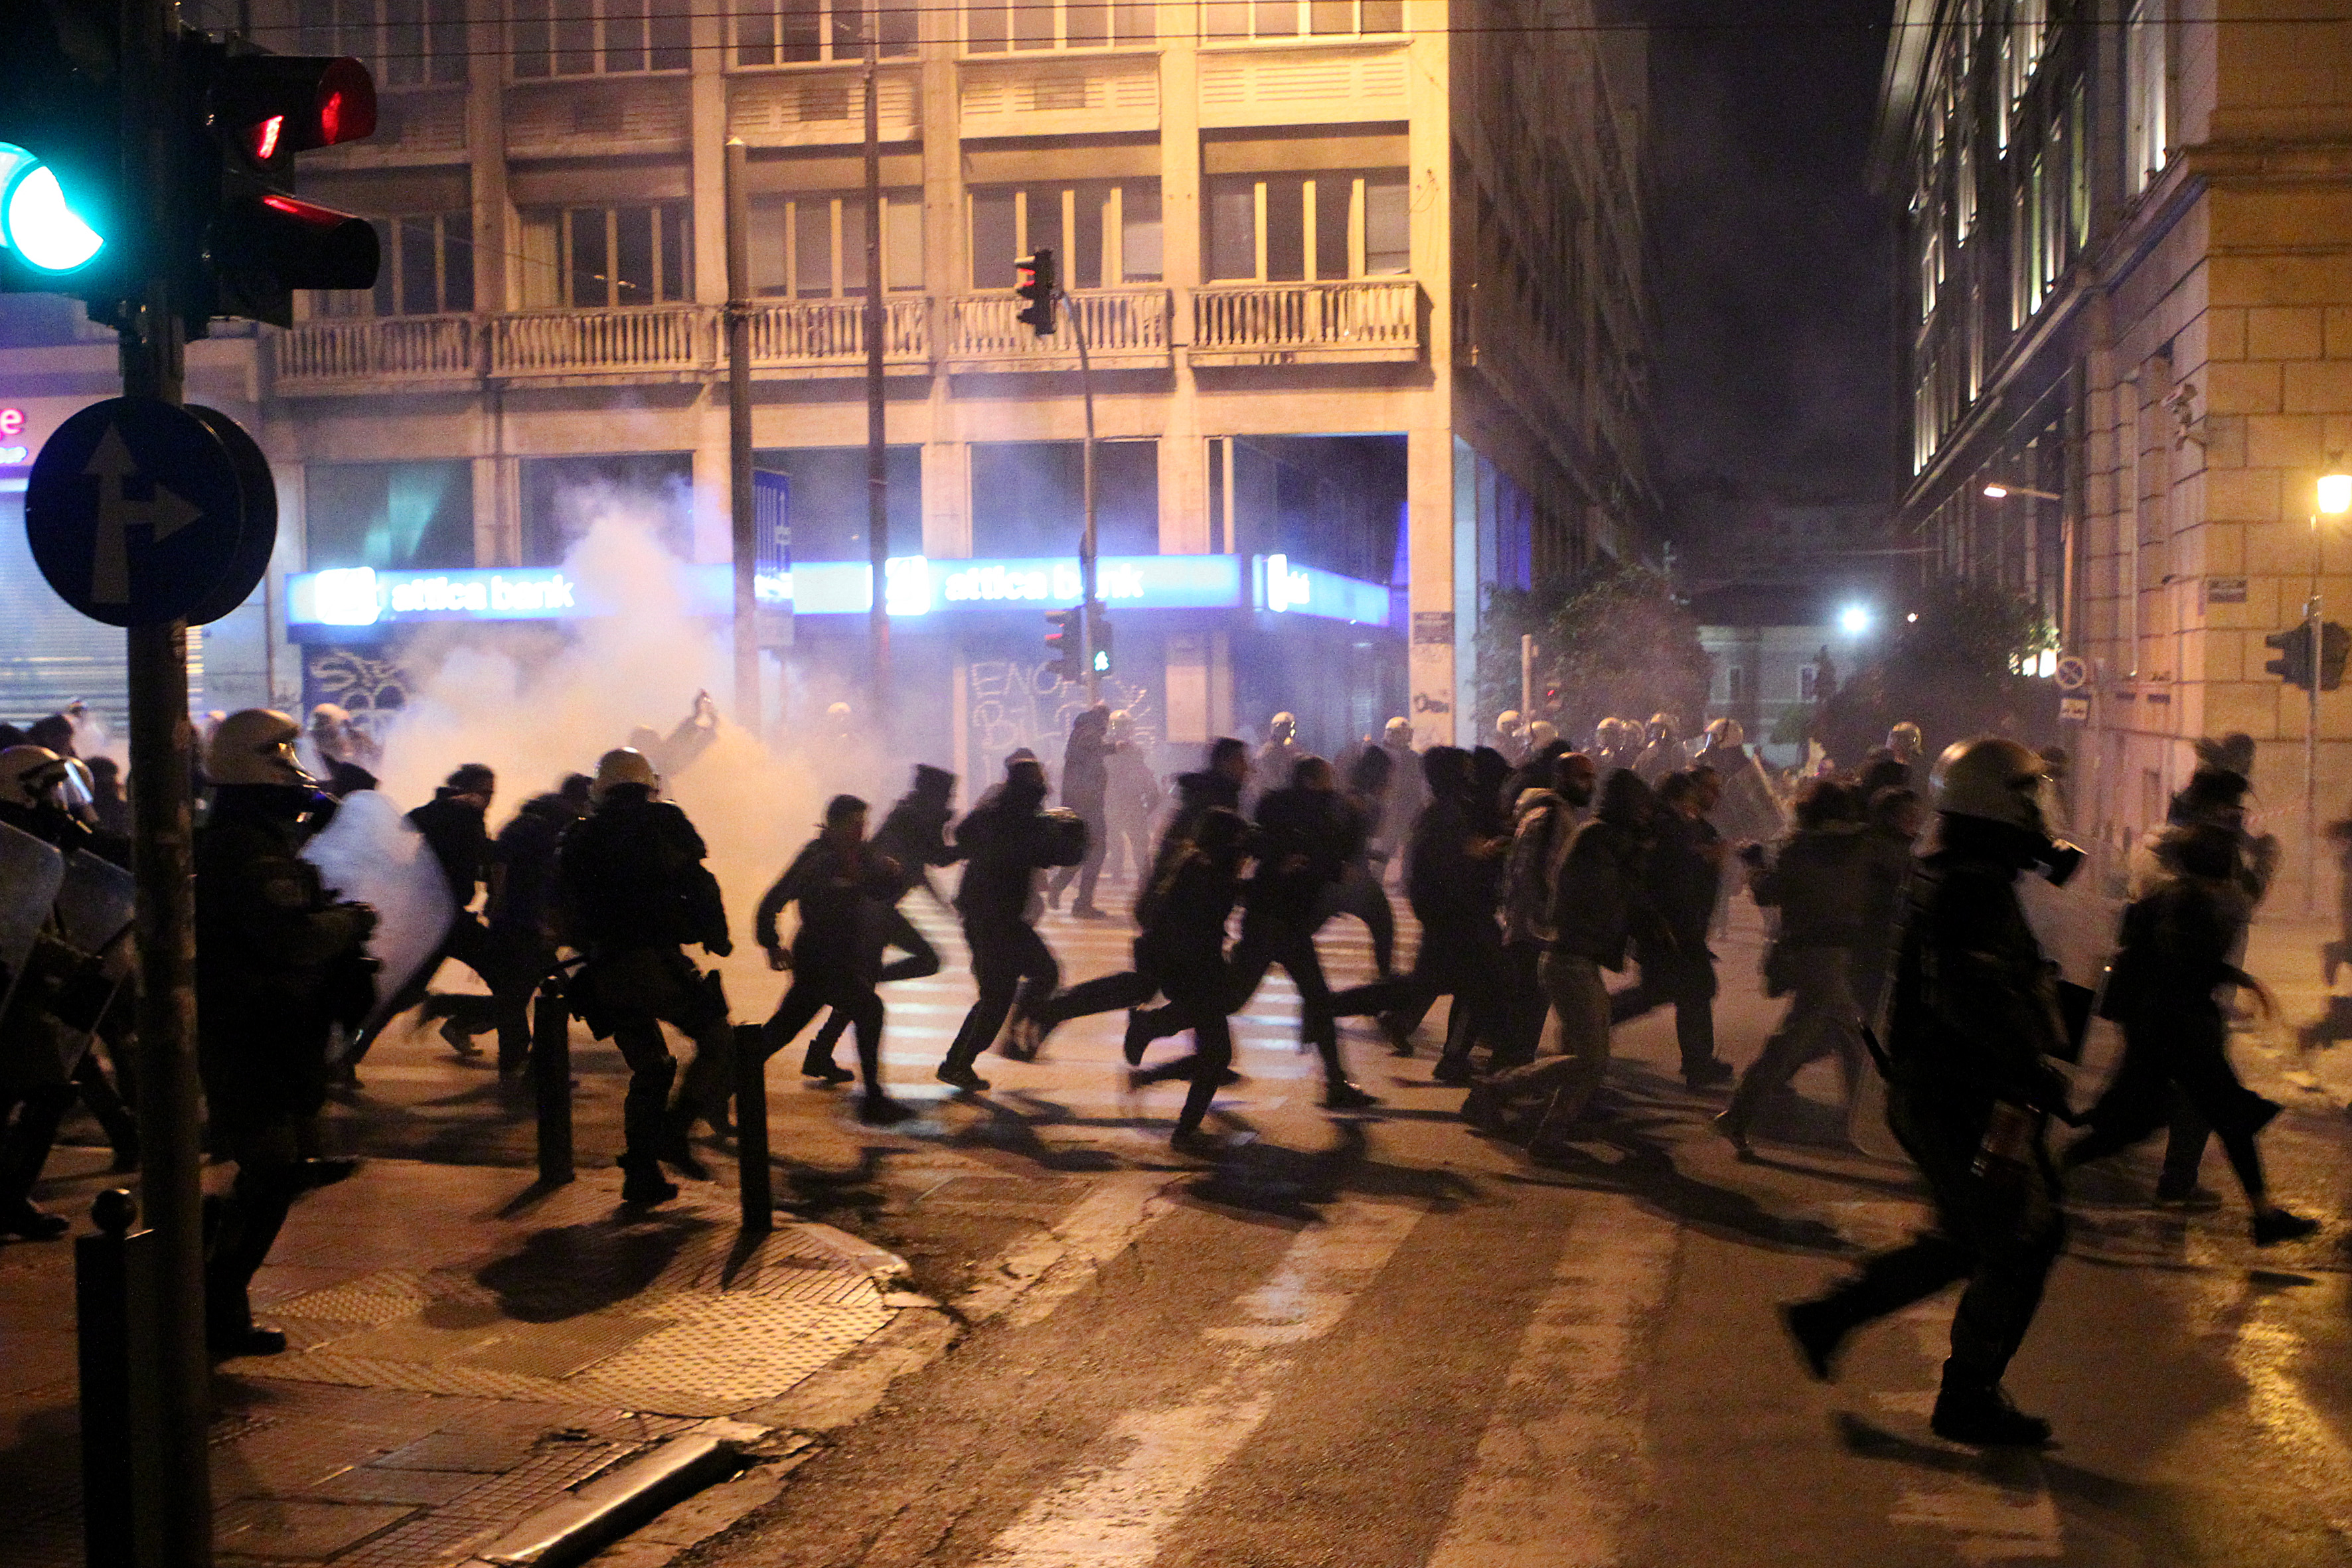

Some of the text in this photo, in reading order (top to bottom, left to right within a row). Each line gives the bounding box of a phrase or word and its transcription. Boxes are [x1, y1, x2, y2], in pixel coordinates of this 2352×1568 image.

[392, 574, 575, 611] attica bank
[945, 565, 1048, 601] attica
